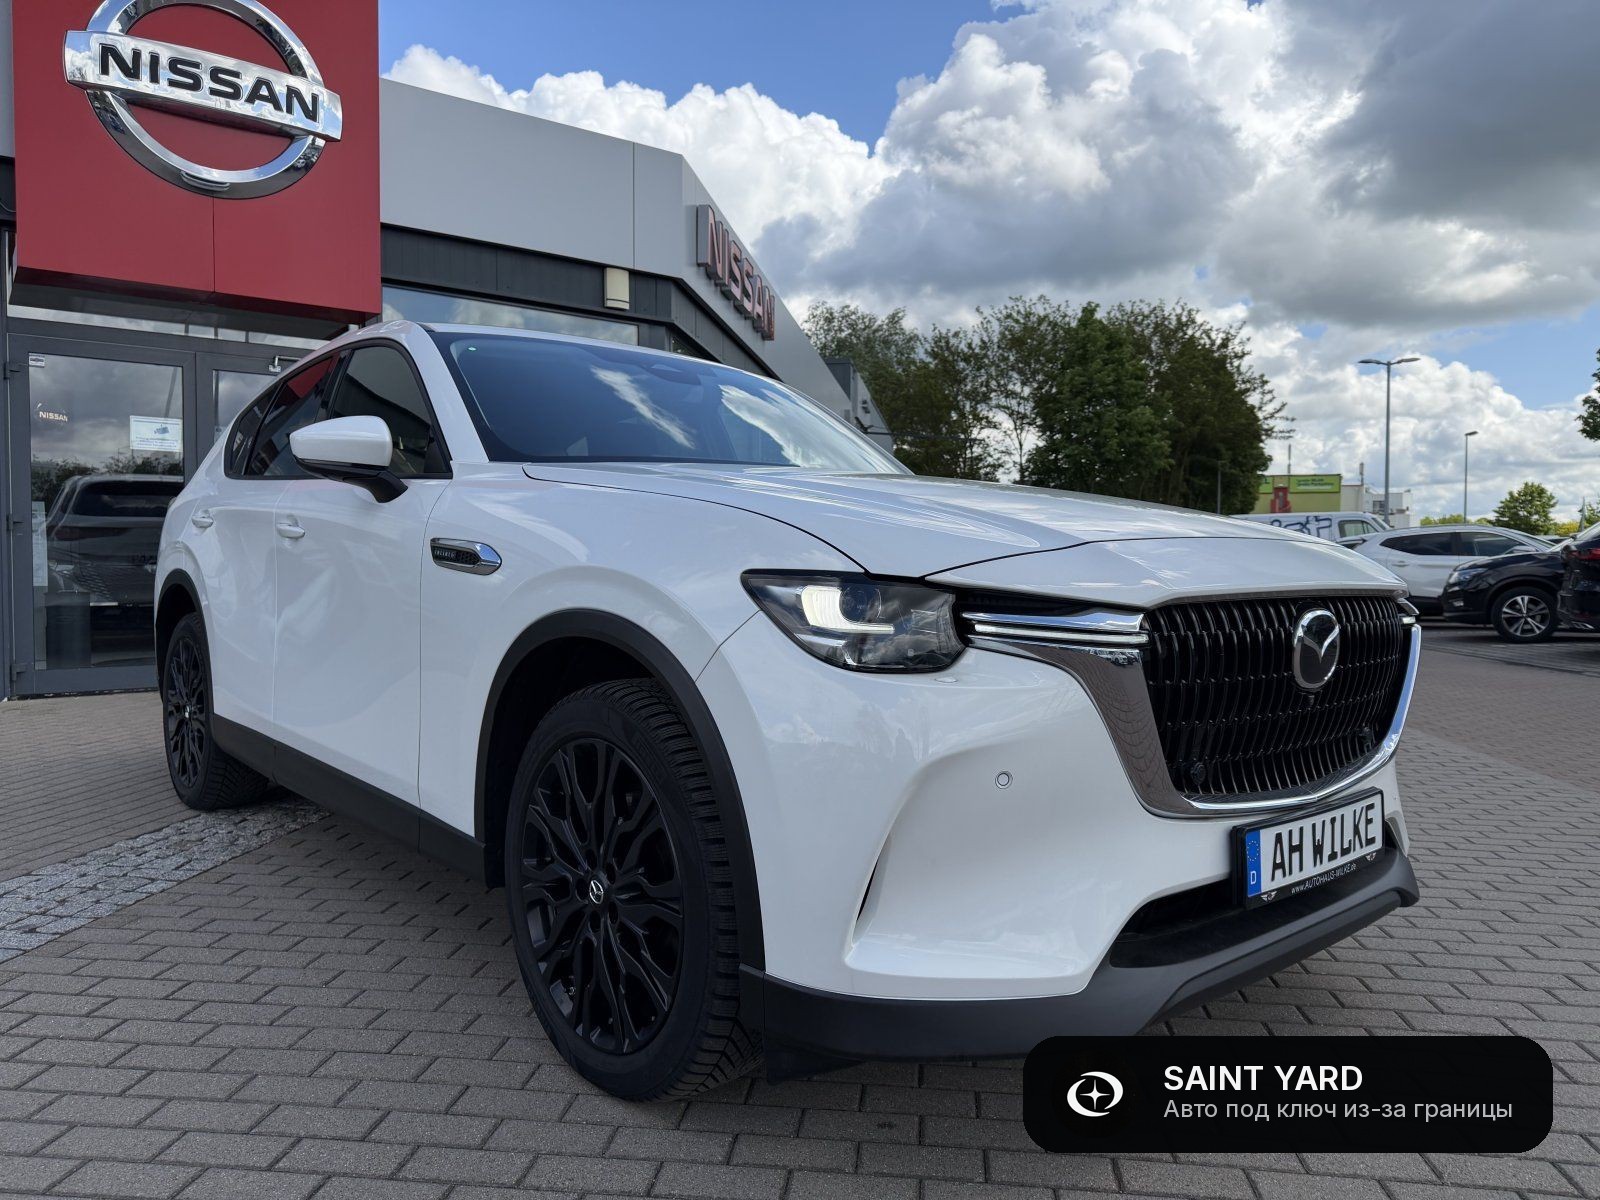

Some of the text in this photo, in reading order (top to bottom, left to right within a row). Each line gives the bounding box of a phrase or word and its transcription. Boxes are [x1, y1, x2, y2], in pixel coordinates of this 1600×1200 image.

[99, 43, 320, 122] NISSAN
[696, 204, 775, 340] NISSAN
[39, 411, 68, 422] NISSAN
[1250, 870, 1257, 885] D
[1271, 803, 1376, 882] AH WILKE
